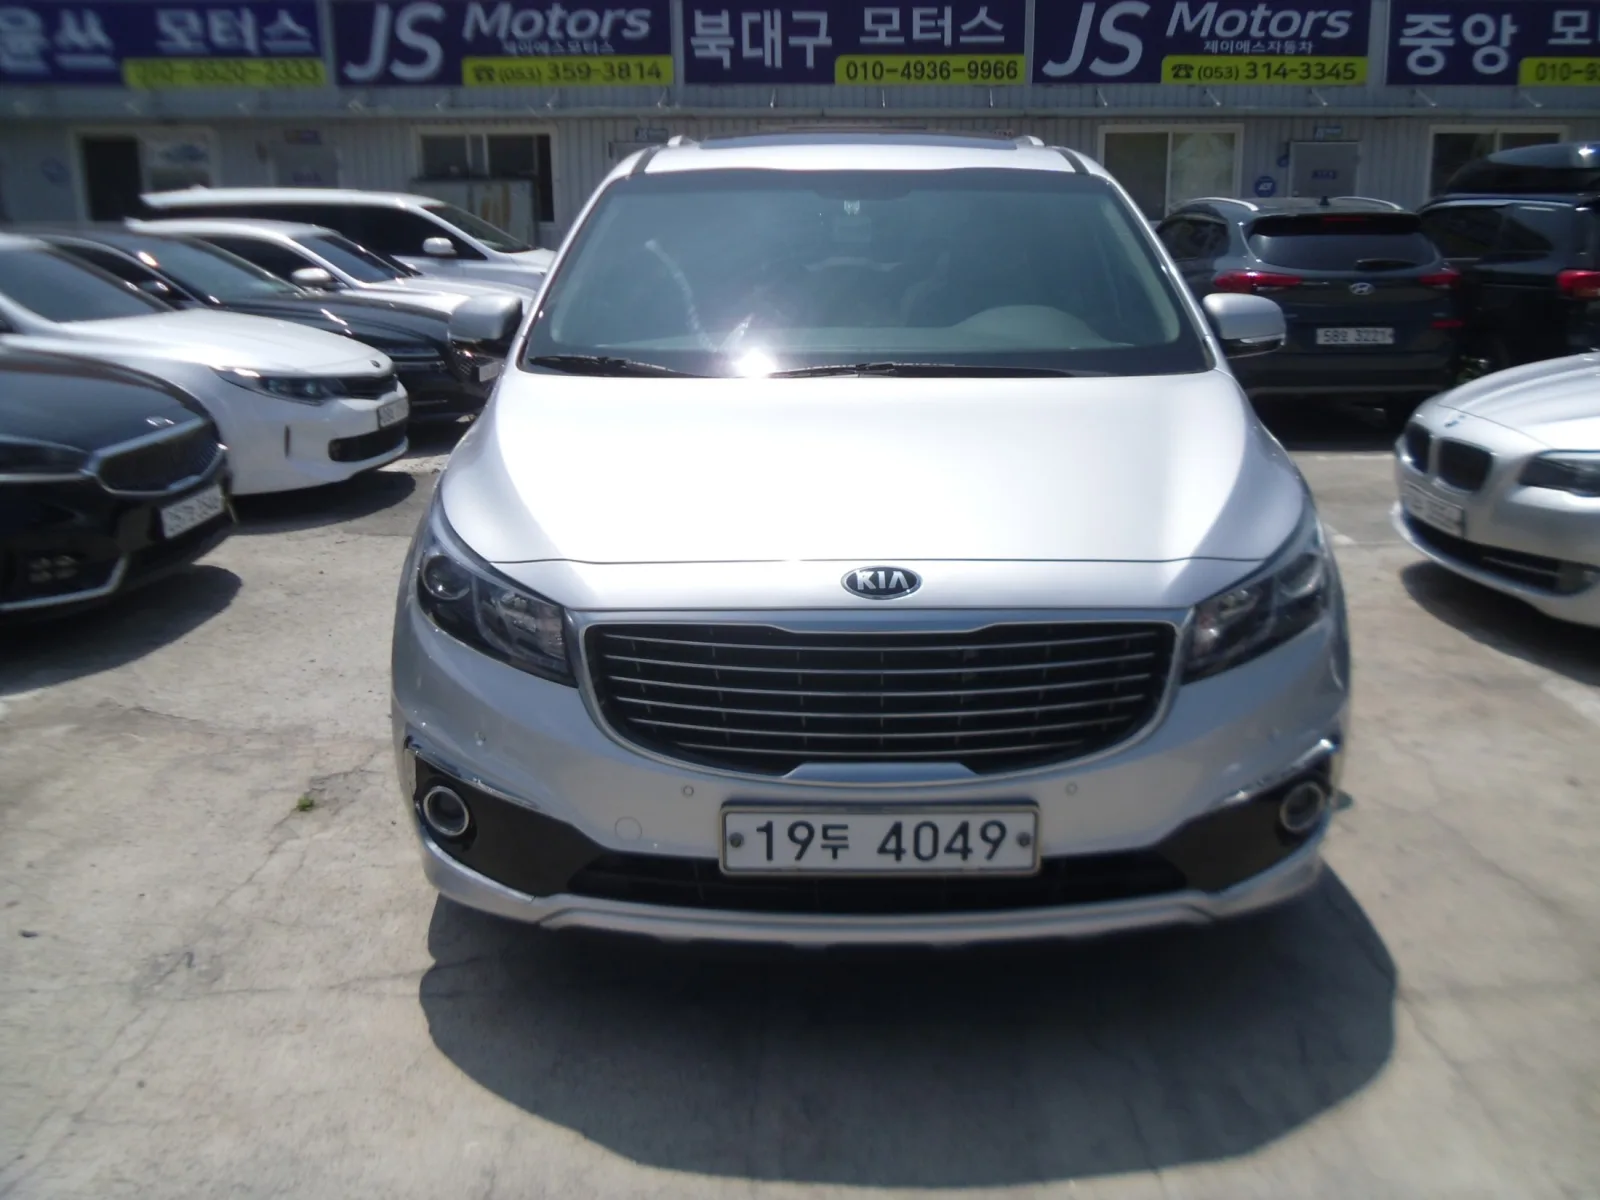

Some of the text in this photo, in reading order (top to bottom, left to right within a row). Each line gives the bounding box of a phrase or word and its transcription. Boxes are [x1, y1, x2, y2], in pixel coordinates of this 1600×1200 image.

[154, 7, 316, 57] 모터스
[461, 2, 653, 41] Motors
[690, 6, 1006, 70] 북대구 모터스
[1041, 0, 1151, 77] JS
[1165, 1, 1354, 40] Motors
[343, 2, 447, 82] JS
[1203, 39, 1313, 55] 제이에스자동차
[1398, 9, 1600, 76] 중앙 모
[501, 61, 662, 84] (053) 359-3814
[845, 59, 1019, 81] 010-4936-9966
[1196, 61, 1357, 82] (053) 314-3345
[1535, 62, 1600, 82] 010-9
[855, 569, 910, 591] KIA
[755, 820, 1007, 862] 19두 4049
